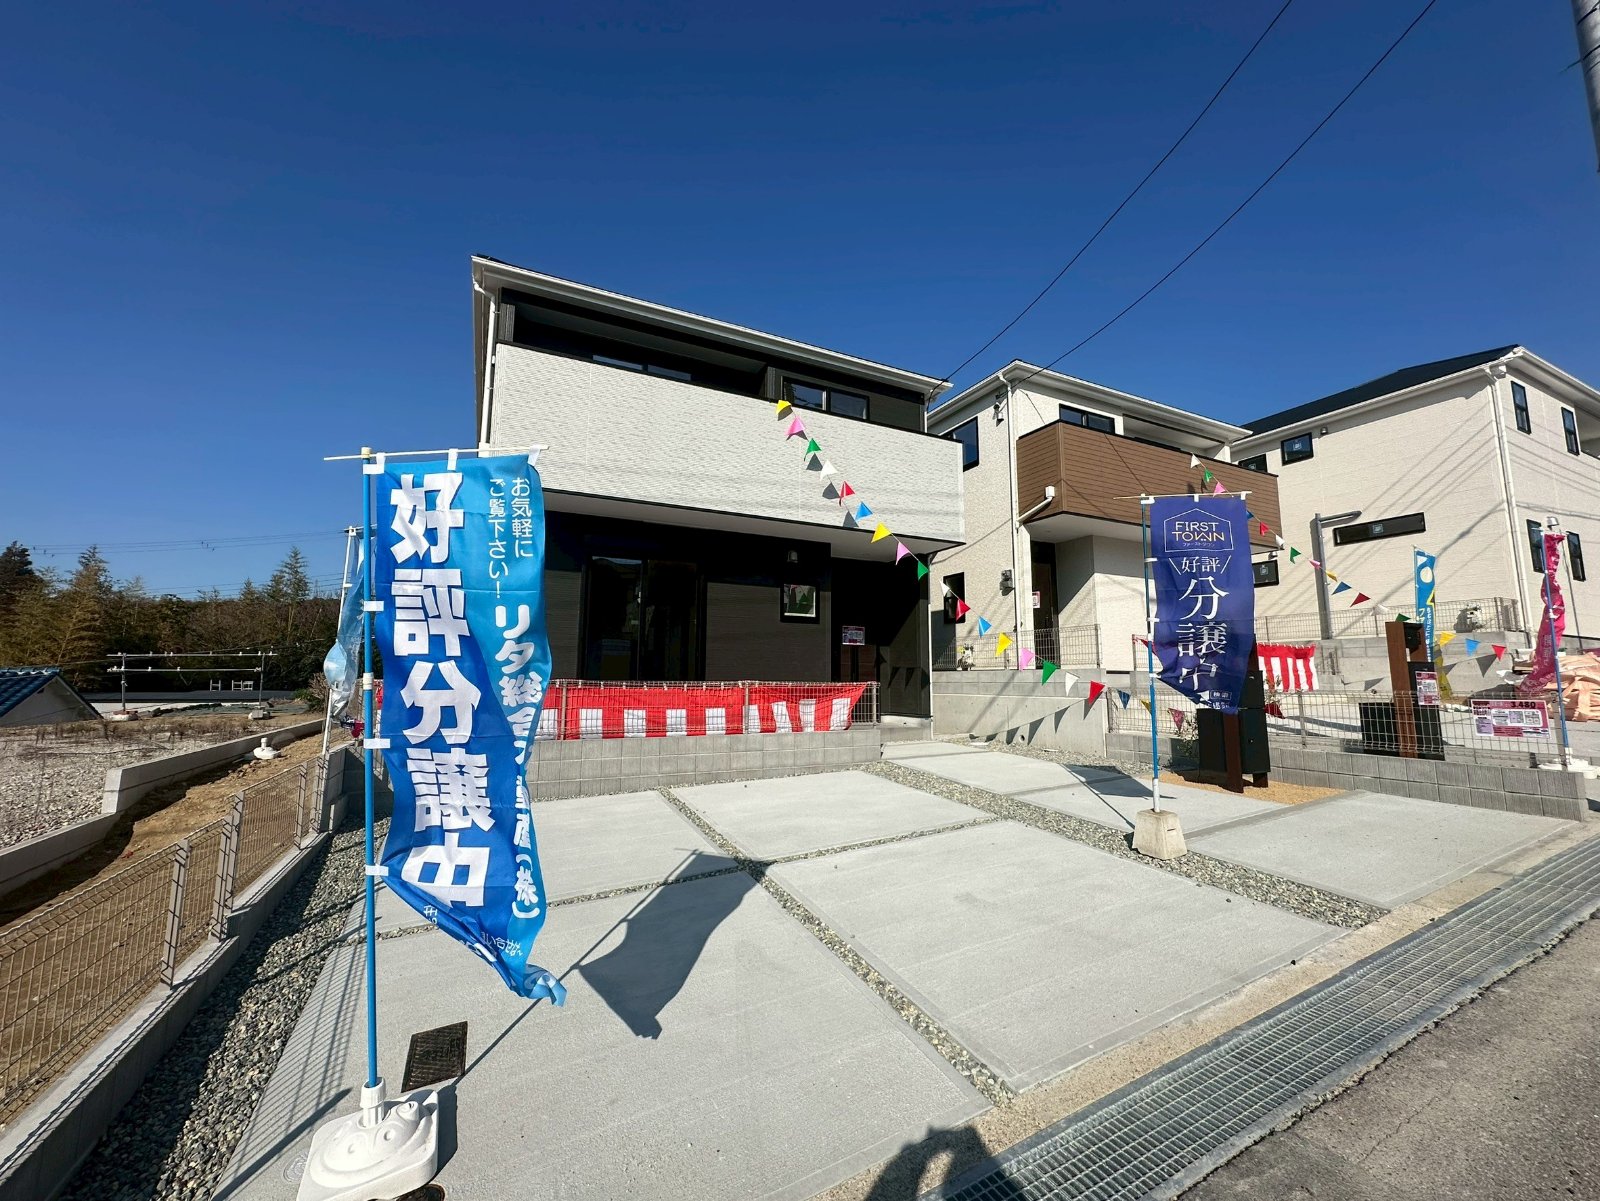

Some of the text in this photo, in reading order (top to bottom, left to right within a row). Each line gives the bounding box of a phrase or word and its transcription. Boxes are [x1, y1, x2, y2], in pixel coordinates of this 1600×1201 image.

[488, 478, 509, 599] ご覧下さい！
[511, 477, 534, 558] お気軽に
[1172, 531, 1225, 541] TOWN
[1175, 521, 1219, 531] FIRST
[1181, 556, 1221, 574] 好評
[1176, 575, 1229, 691] 分譲中
[390, 473, 496, 908] 好評分譲中
